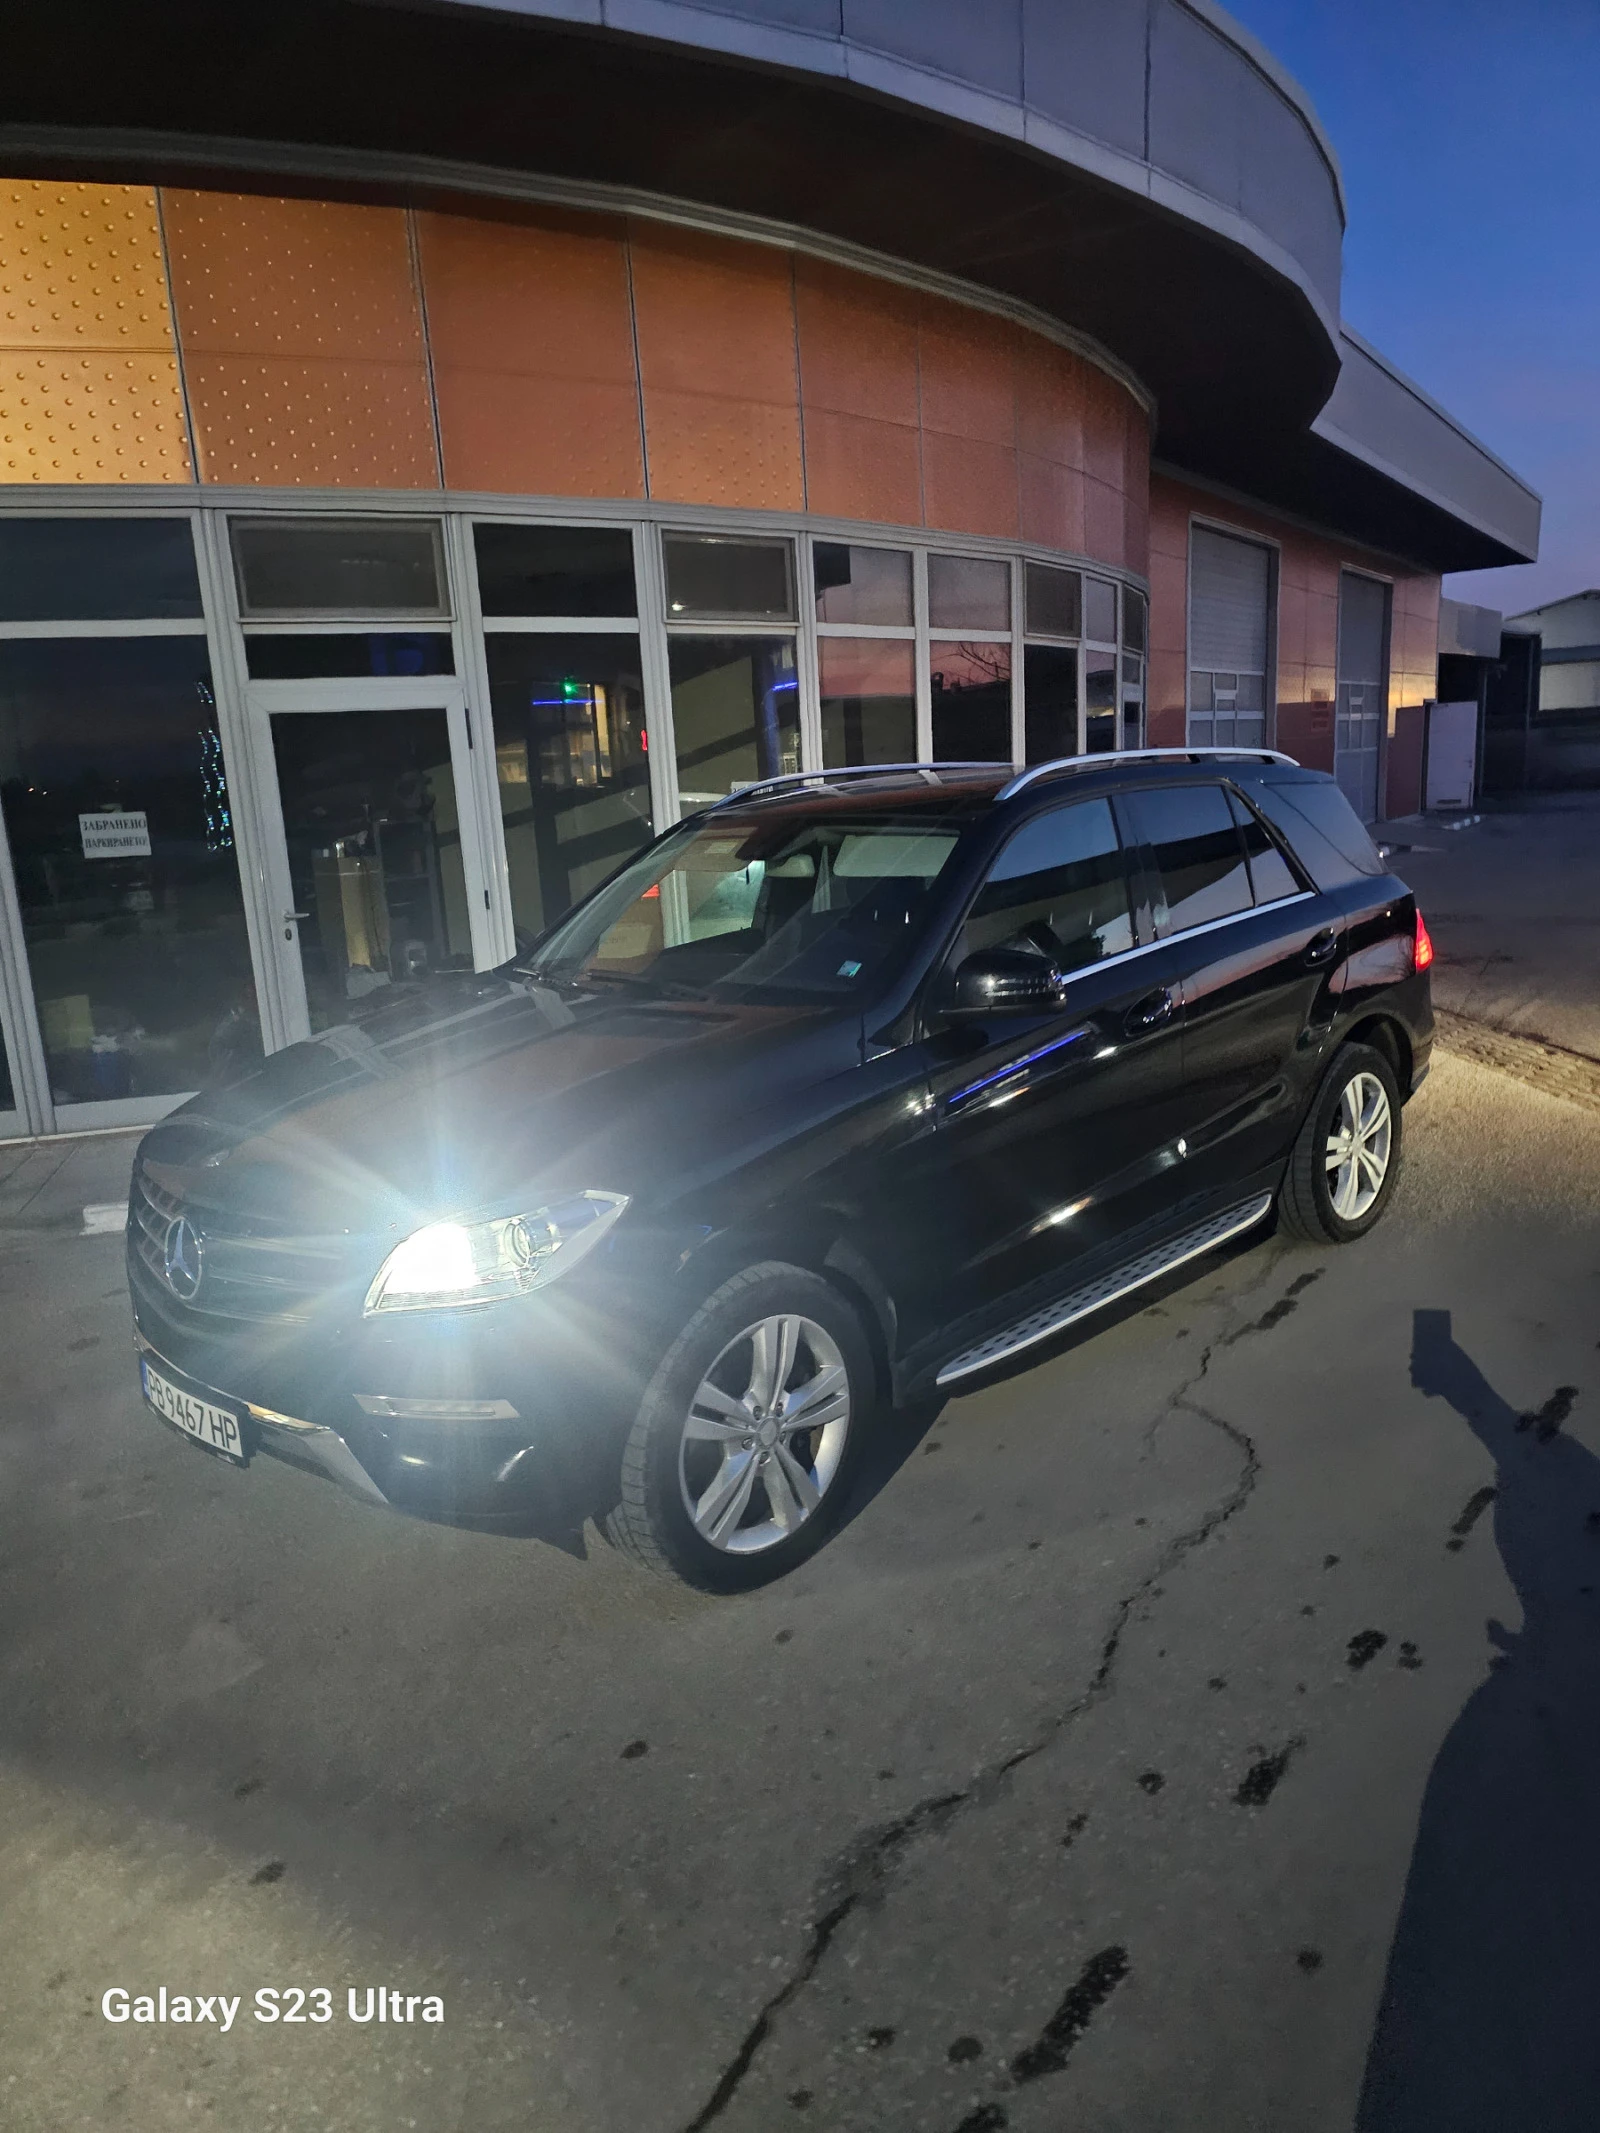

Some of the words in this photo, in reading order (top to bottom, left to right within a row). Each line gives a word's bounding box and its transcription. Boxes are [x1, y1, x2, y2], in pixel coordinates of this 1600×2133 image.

[81, 819, 147, 831] ЗАБРАНЕНО
[165, 1386, 204, 1436] 9467
[208, 1410, 237, 1450] HP
